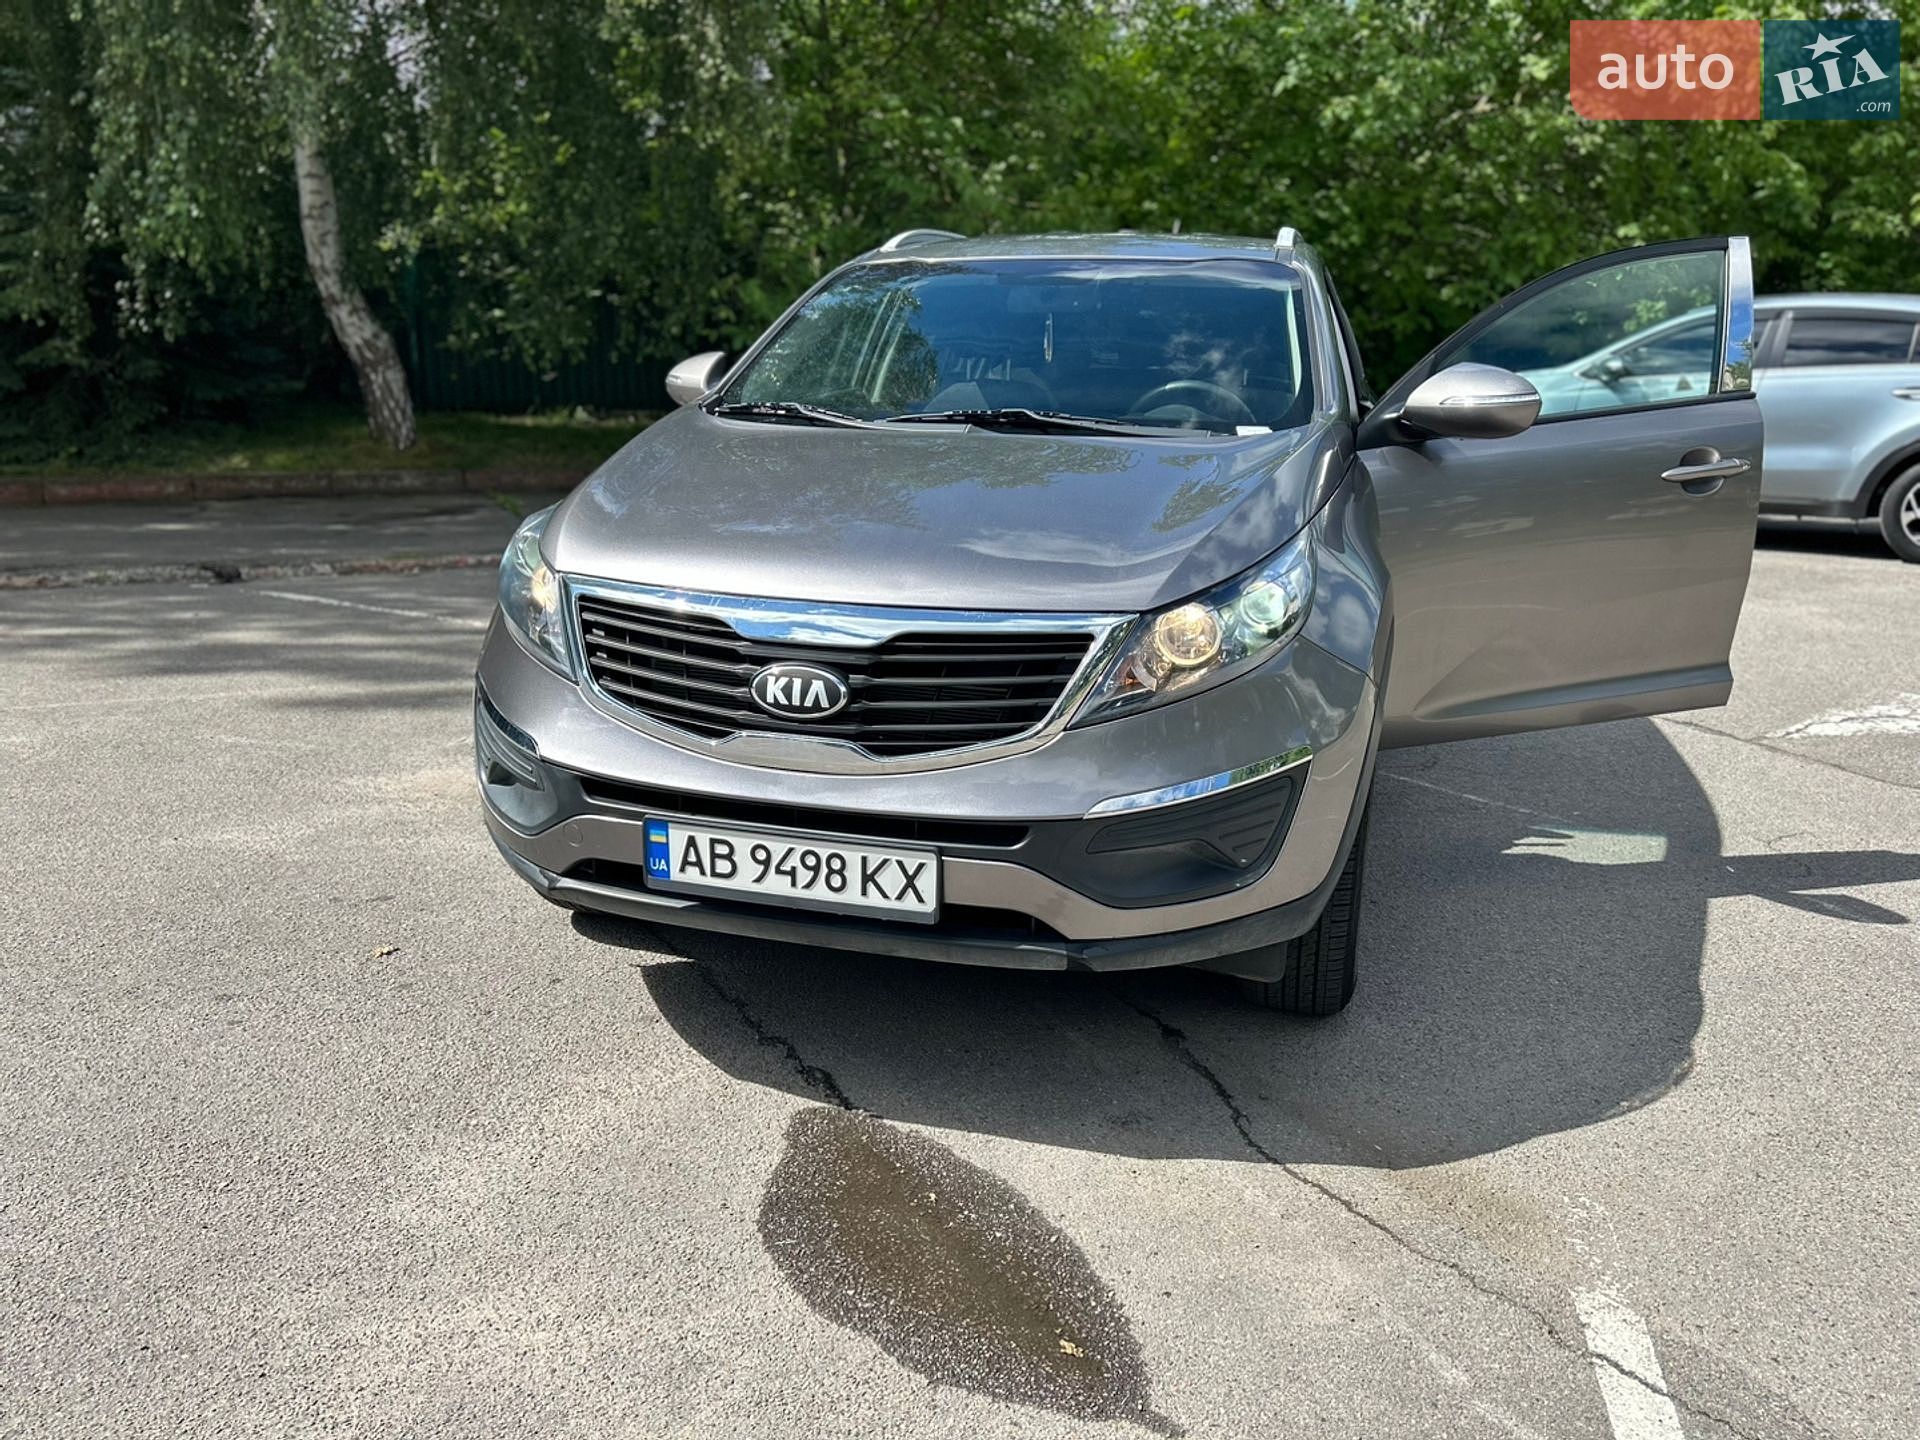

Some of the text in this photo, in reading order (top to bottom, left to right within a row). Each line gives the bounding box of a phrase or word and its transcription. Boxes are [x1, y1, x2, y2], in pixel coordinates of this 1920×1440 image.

[766, 675, 830, 708] KIA
[650, 857, 668, 872] UA
[678, 834, 928, 904] AB 9498 KX
